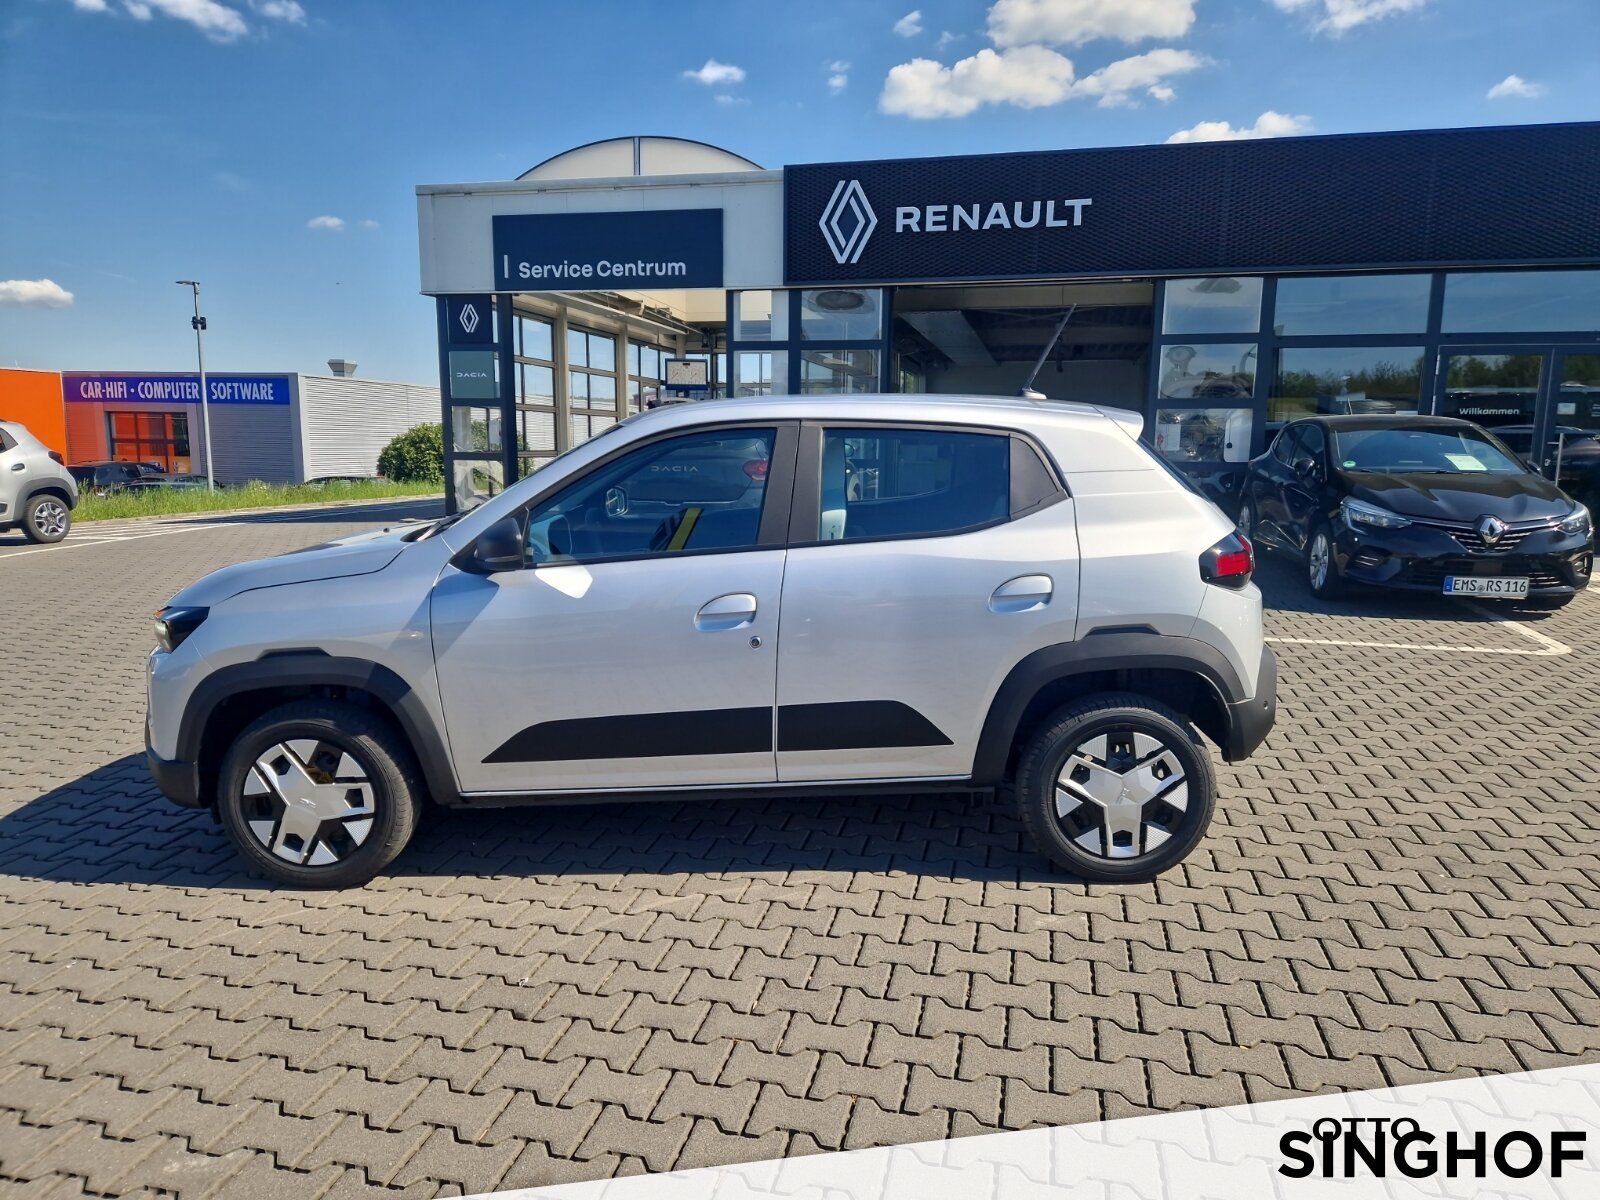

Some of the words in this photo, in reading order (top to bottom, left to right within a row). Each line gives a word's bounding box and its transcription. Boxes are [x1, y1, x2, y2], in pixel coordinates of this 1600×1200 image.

[896, 198, 1093, 233] RENAULT
[518, 261, 593, 279] Service
[596, 259, 686, 277] Centrum
[80, 381, 127, 398] CAR-HIFI
[137, 382, 199, 400] COMPUTER
[210, 383, 274, 400] SOFTWARE
[1453, 579, 1477, 591] EMS
[1486, 580, 1502, 592] RS
[1504, 580, 1526, 593] 116
